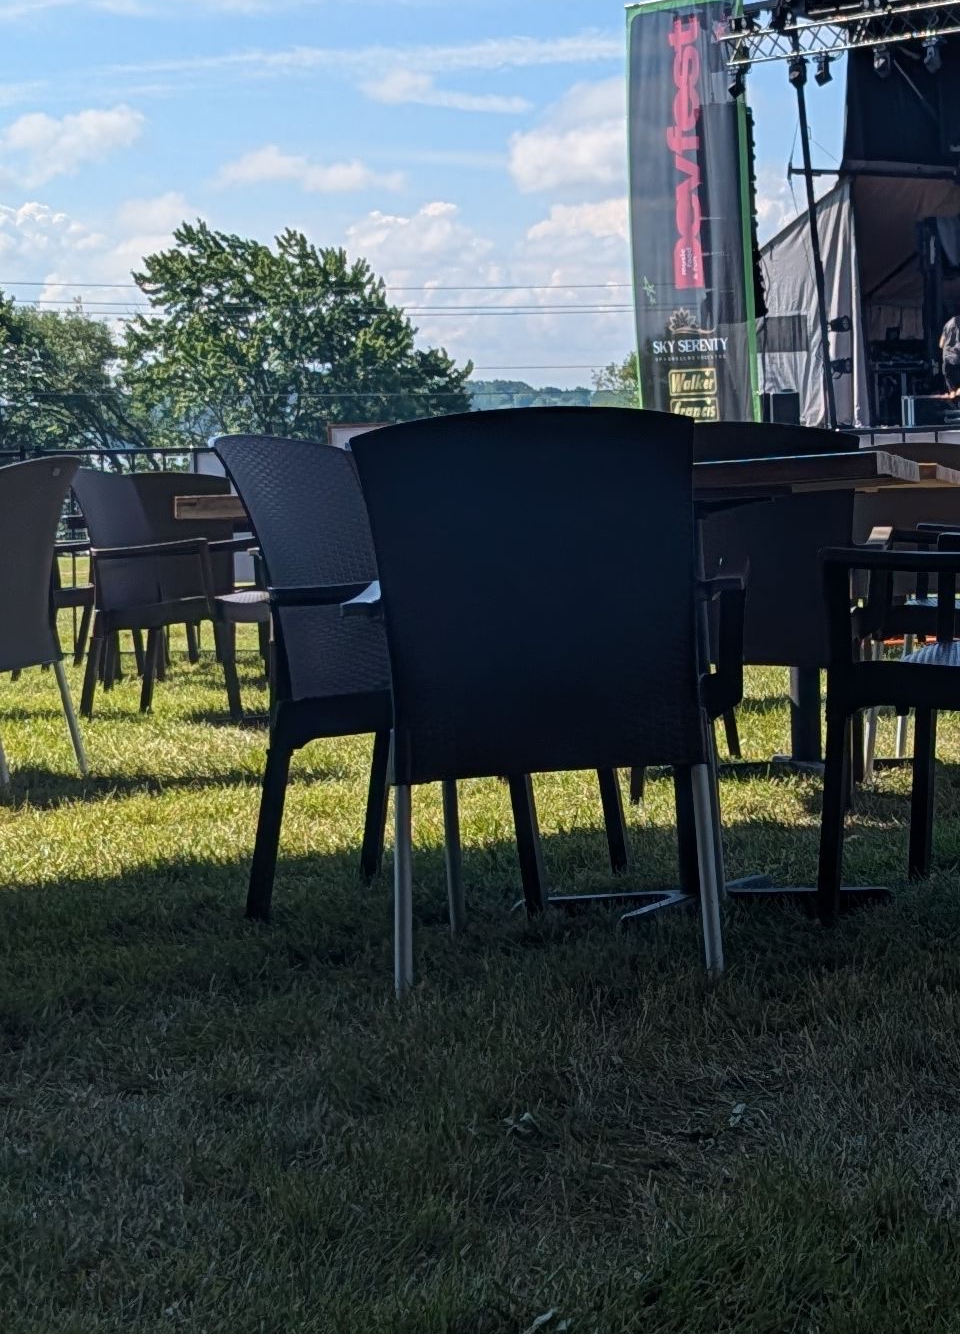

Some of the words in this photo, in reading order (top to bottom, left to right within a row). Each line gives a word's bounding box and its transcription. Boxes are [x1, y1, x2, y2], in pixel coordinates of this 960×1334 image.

[666, 14, 706, 289] Devfest
[652, 340, 676, 355] SKY
[677, 336, 729, 354] SERENITY
[671, 372, 715, 393] Walker
